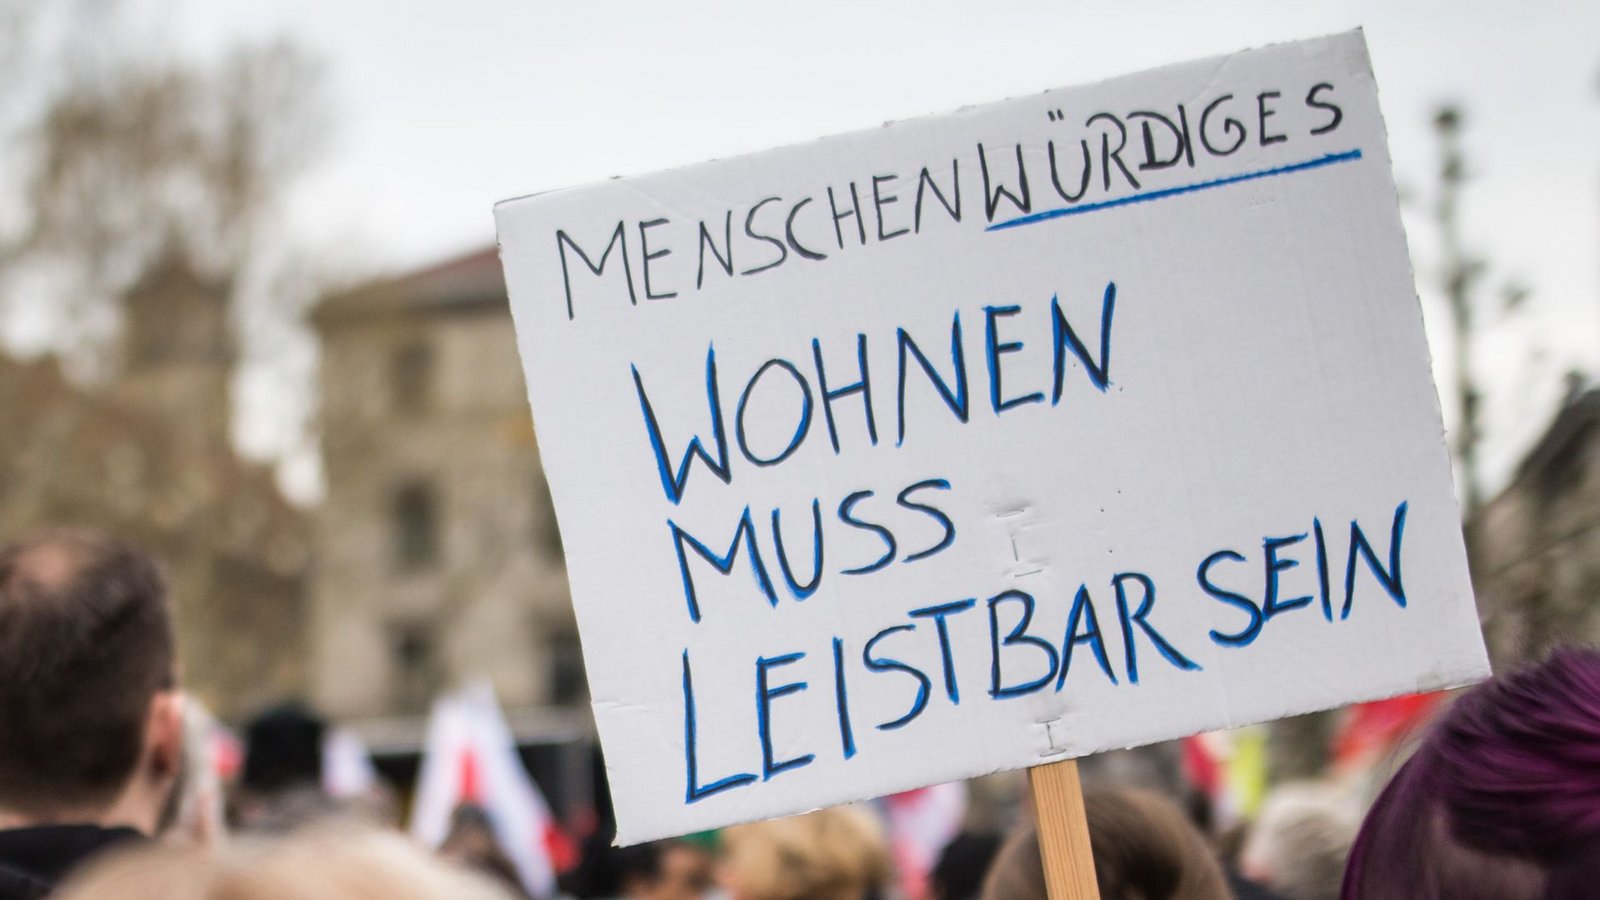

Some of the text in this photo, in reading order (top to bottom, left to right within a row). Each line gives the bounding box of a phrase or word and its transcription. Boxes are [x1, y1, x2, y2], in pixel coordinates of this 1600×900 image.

[556, 82, 1345, 320] MENSCHENWÜRDIGES
[630, 281, 1118, 506] WOHNEN
[666, 478, 957, 623] MUSS
[682, 500, 1410, 805] LEISTBAR SEIN
